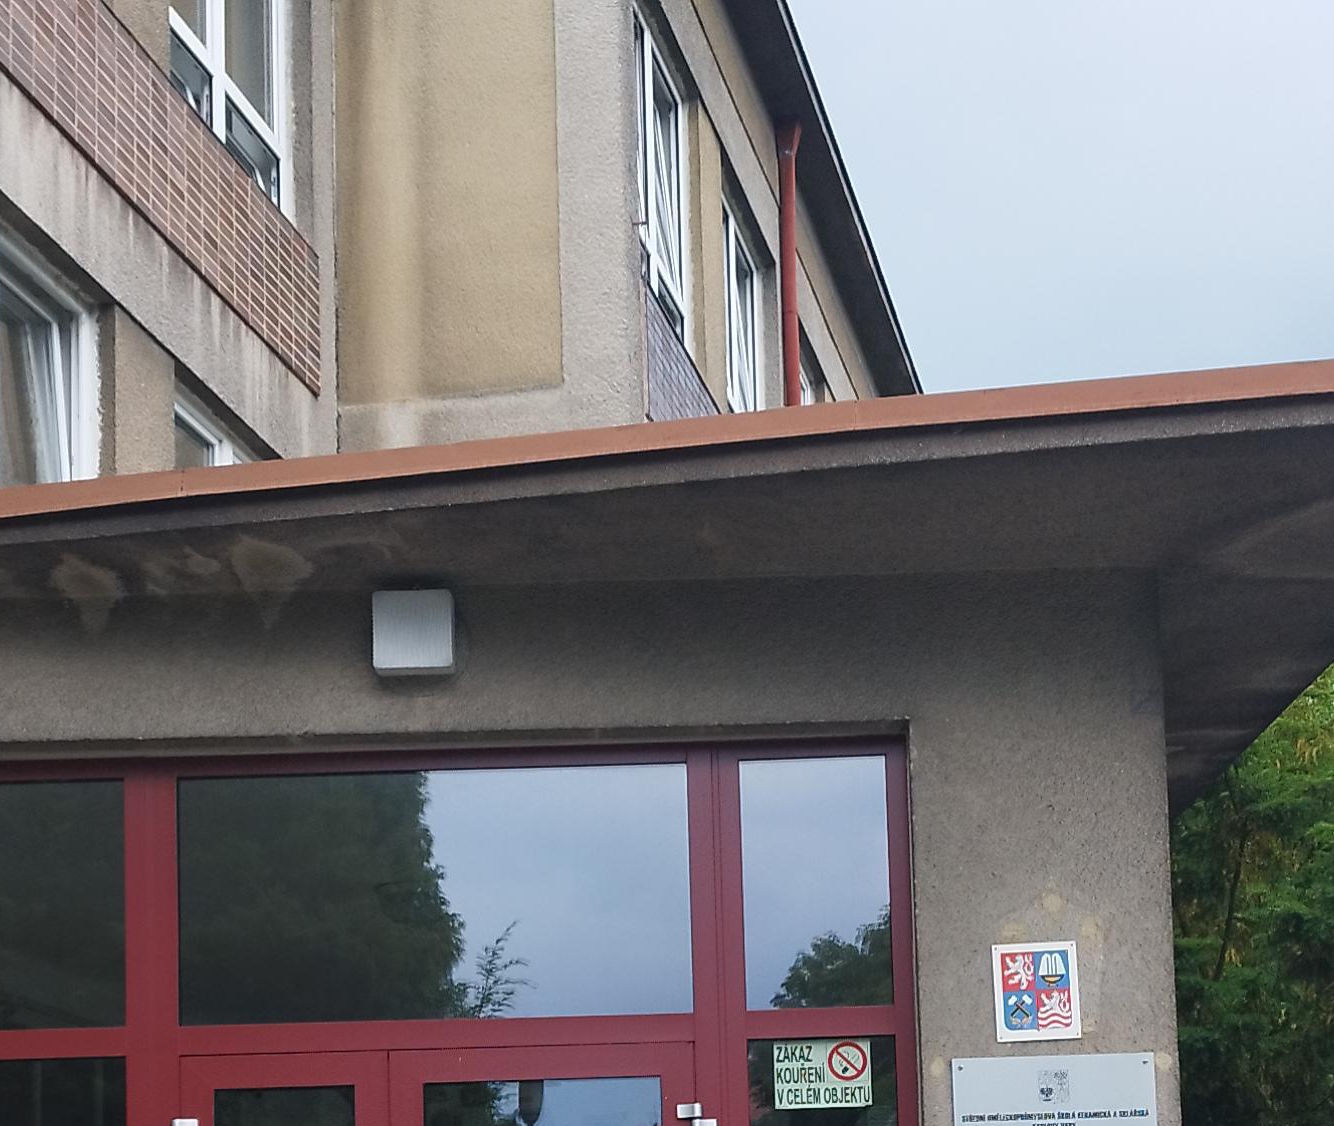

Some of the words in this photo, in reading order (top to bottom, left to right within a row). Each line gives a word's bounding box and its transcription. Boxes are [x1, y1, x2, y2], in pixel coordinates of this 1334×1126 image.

[776, 1043, 813, 1063] ZÁKAZ
[776, 1062, 826, 1084] KOUŘENÍ
[777, 1088, 785, 1105] V
[786, 1084, 821, 1105] CELÉM
[823, 1085, 870, 1105] OBJEKTU
